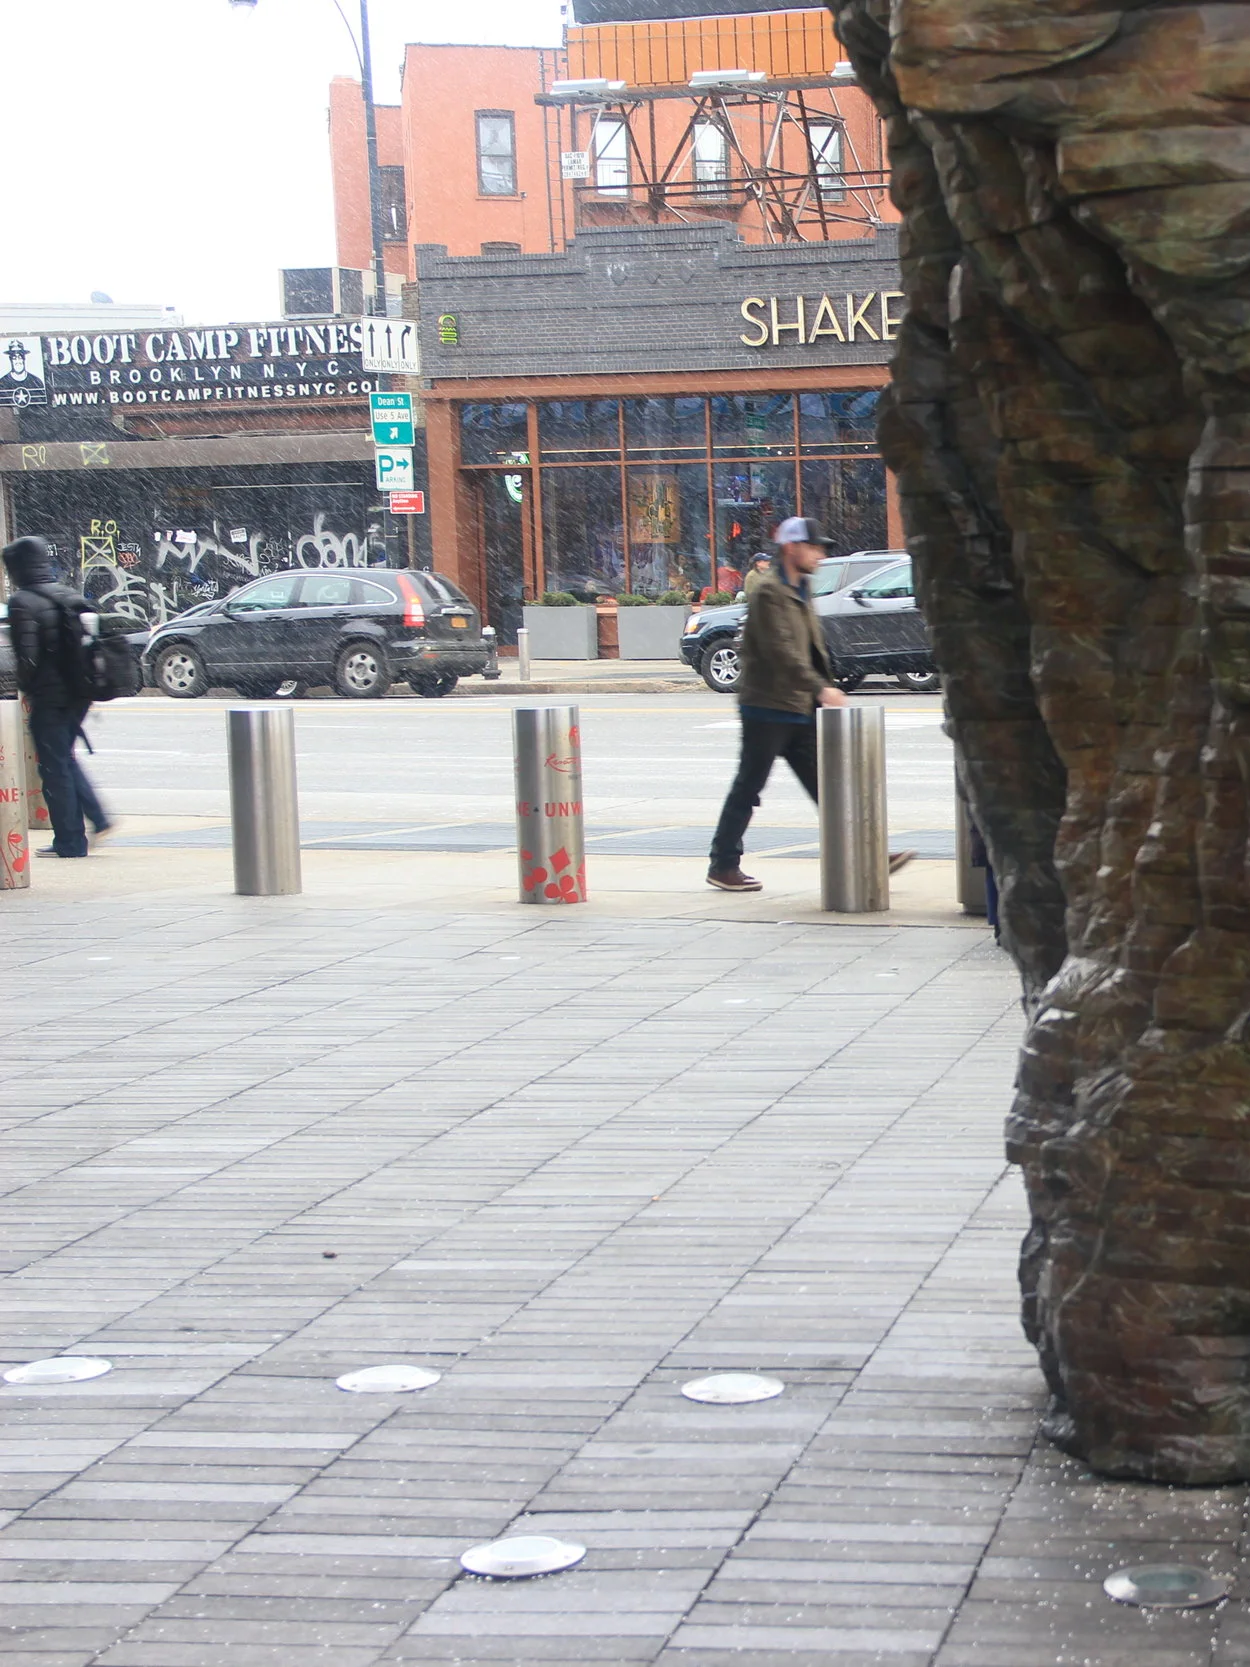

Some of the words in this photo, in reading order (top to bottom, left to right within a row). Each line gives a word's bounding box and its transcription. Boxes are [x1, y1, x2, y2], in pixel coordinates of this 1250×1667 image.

[739, 291, 905, 347] SHAKE
[48, 334, 136, 365] BOOT
[145, 329, 239, 362] CAMP
[364, 358, 381, 368] ONLY
[382, 359, 398, 369] ONLY
[401, 360, 416, 370] ONLY
[90, 364, 242, 385] BROOKLYN
[264, 360, 353, 378] N.Y.C.
[377, 397, 395, 406] Dean
[397, 397, 405, 406] St
[375, 411, 388, 420] Use
[390, 411, 395, 420] 5
[397, 411, 409, 420] Ave
